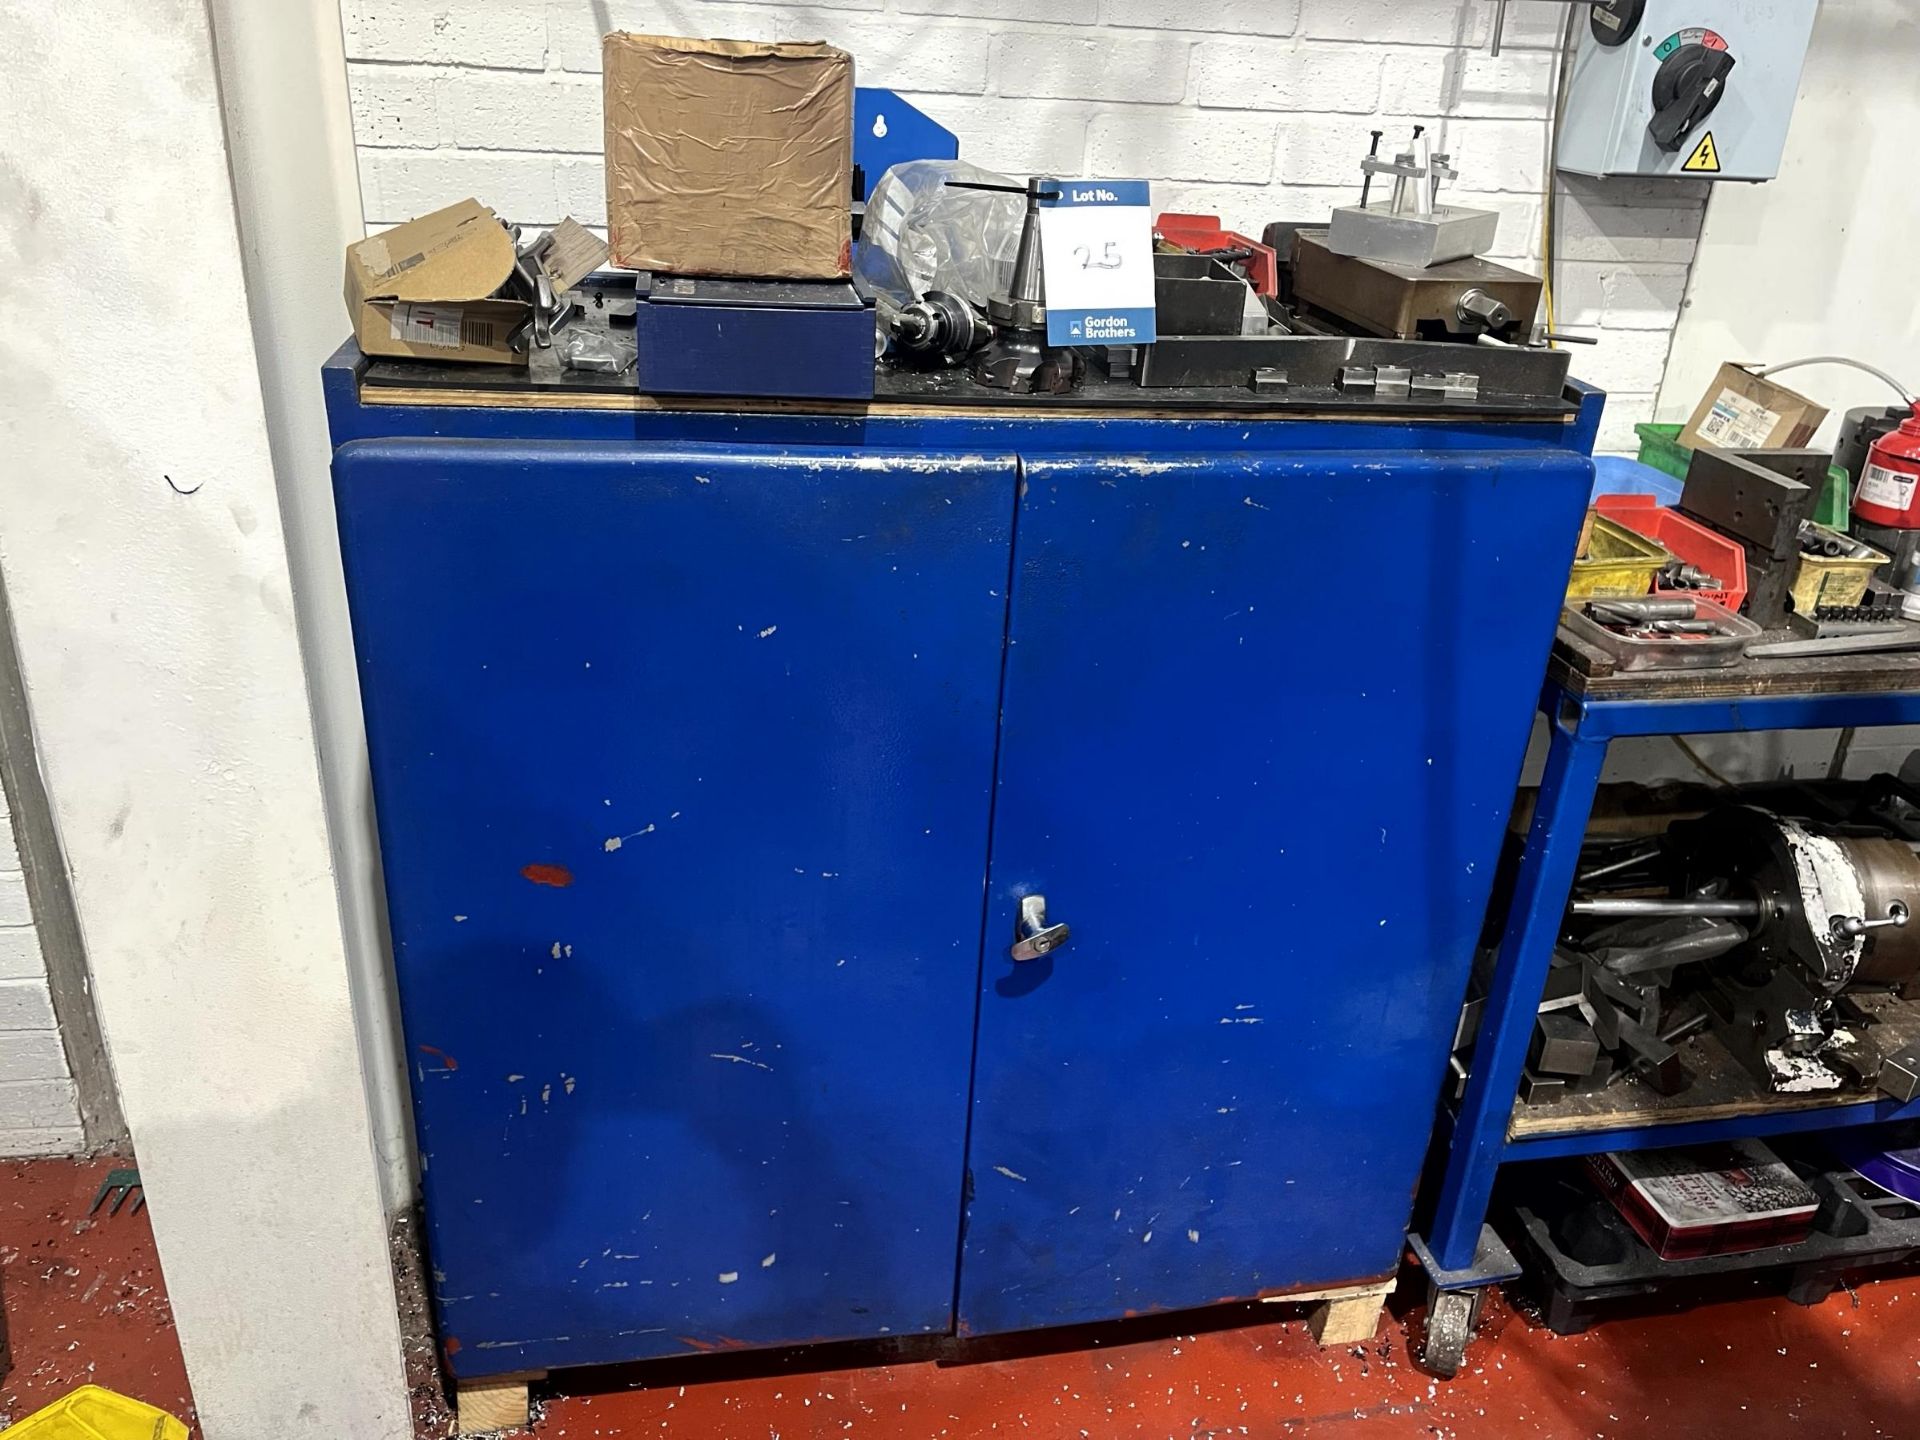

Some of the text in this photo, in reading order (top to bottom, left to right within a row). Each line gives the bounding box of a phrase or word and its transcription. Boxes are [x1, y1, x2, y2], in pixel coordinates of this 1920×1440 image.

[1072, 189, 1118, 203] Lot No.
[1073, 241, 1123, 270] 25
[1084, 316, 1128, 328] Gordon
[1085, 327, 1136, 339] Brothers
